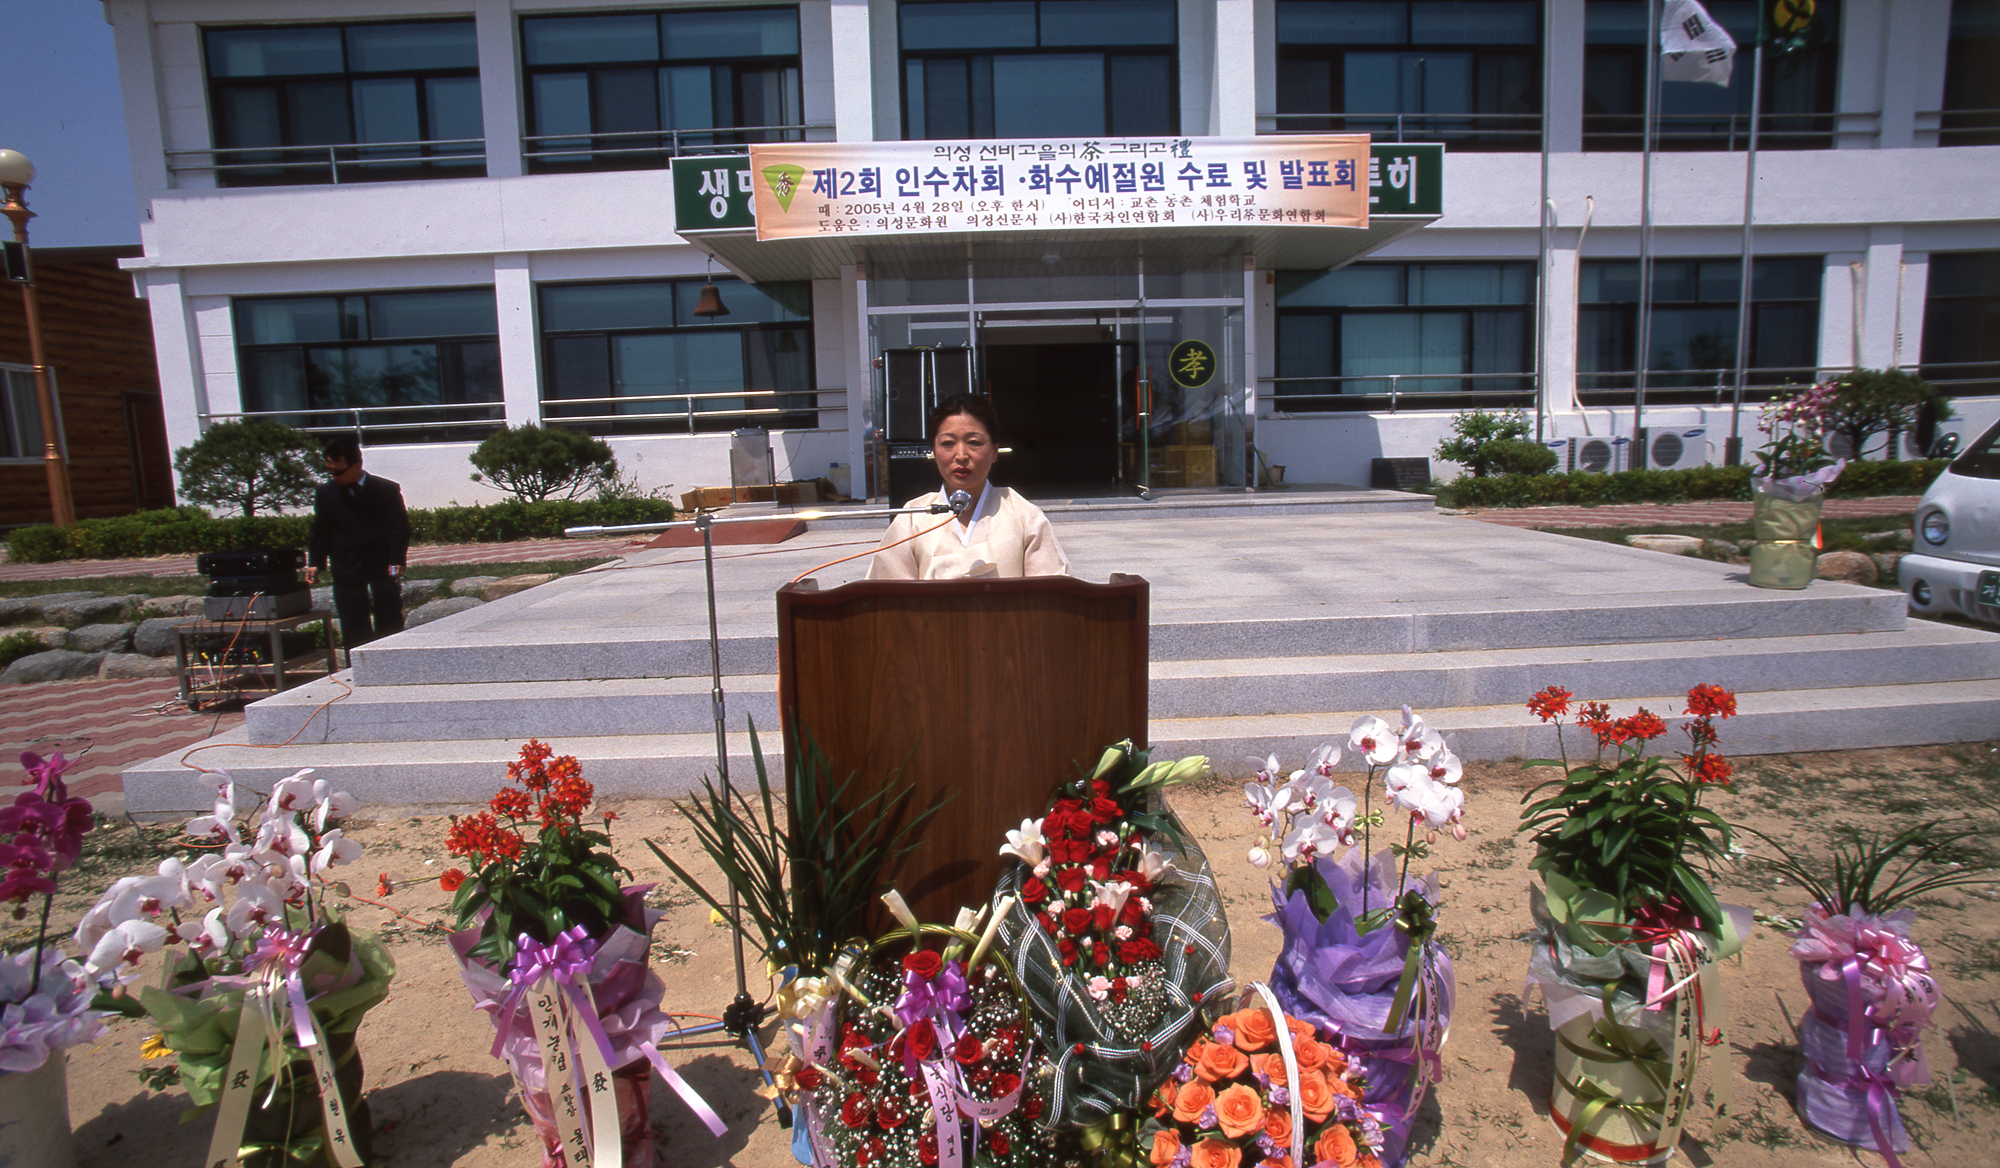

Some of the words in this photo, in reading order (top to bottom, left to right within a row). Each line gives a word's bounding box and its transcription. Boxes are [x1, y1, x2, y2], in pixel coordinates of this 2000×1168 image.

[934, 145, 971, 162] 의성
[812, 167, 882, 199] 제2회
[895, 164, 1005, 197] 인수차회
[1177, 161, 1232, 191] 수료
[1243, 160, 1268, 190] 및
[1280, 159, 1356, 191] 발표회
[845, 202, 895, 215] 2005년
[902, 201, 926, 214] 4월
[932, 200, 963, 214] 28일
[970, 200, 1004, 212] (오후
[1130, 196, 1158, 209] 교촌
[1200, 194, 1257, 207] 체험학교
[876, 214, 948, 230] 의성문화원
[966, 212, 1039, 227] 의성신문사
[1179, 348, 1207, 379] 孝
